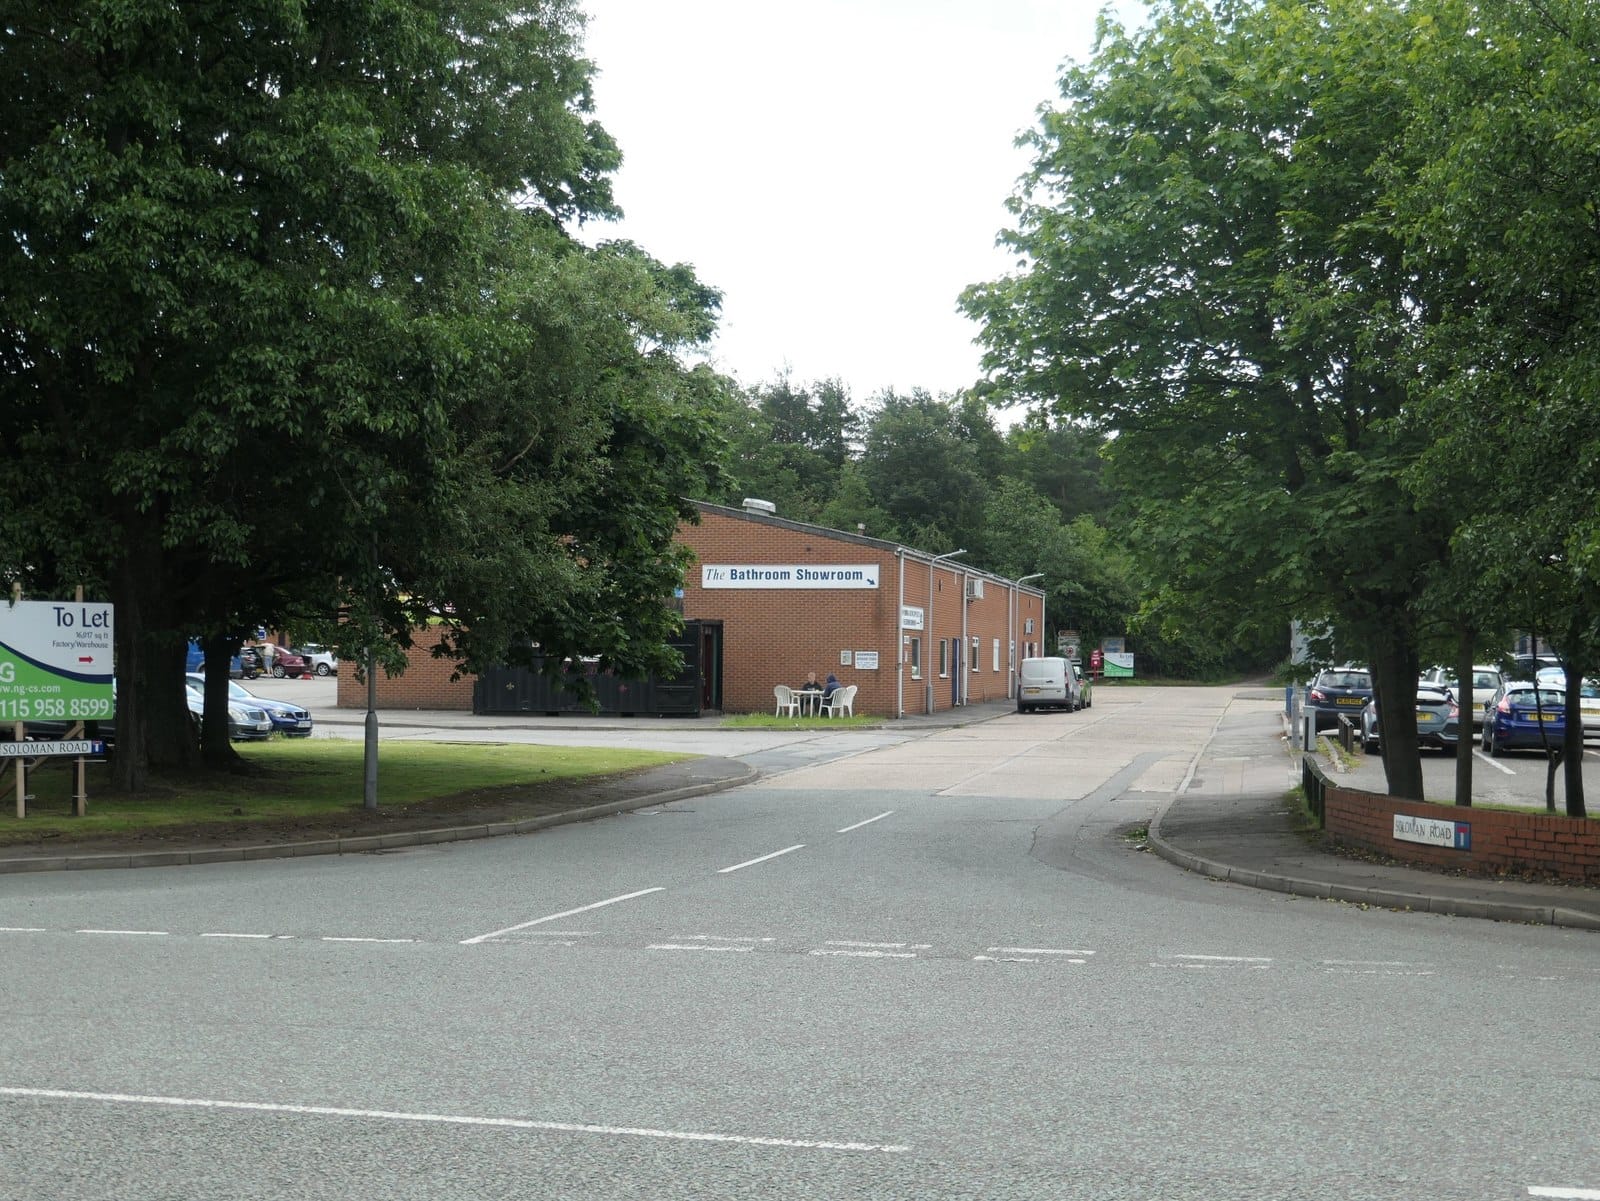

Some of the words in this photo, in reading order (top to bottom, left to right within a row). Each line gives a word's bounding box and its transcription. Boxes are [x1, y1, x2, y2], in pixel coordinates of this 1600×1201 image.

[706, 568, 726, 581] The
[730, 568, 791, 581] Bathroom
[796, 568, 863, 581] Showroom
[53, 607, 74, 627] To
[82, 607, 110, 628] Let
[52, 640, 109, 649] Factory/Warehouse
[34, 699, 65, 717] 958
[70, 698, 109, 717] 8599
[2, 743, 55, 755] SOLOMAN
[59, 742, 89, 753] ROAD
[1429, 825, 1452, 840] ROAD
